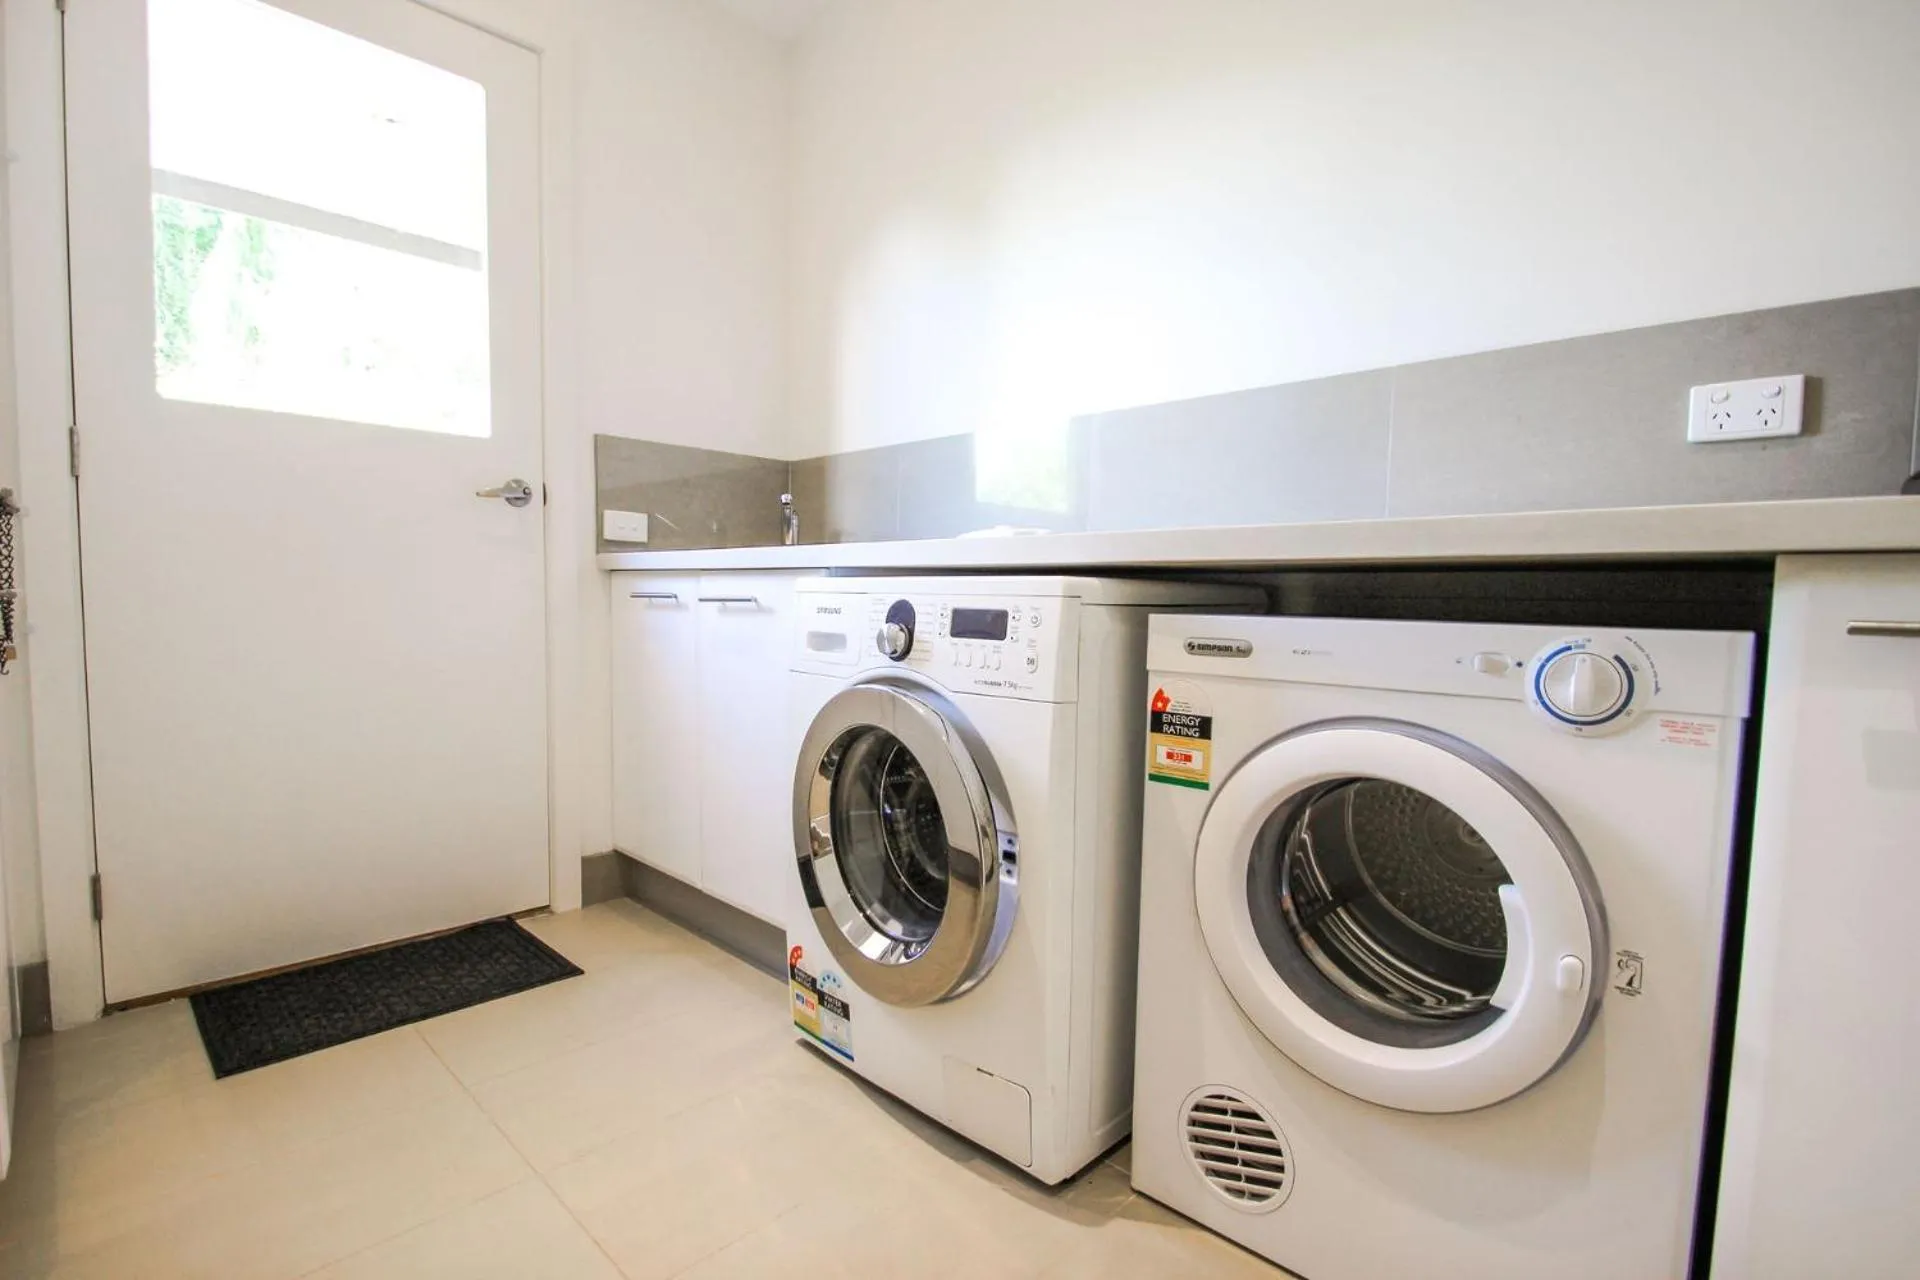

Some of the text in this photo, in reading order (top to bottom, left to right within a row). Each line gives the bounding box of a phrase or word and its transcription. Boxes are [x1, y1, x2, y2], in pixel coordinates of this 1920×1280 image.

[816, 607, 842, 615] SAMSUNG
[1162, 713, 1201, 727] ENERGY
[1162, 724, 1200, 737] RATING
[824, 993, 842, 1007] WATER
[824, 1000, 844, 1017] RATING
